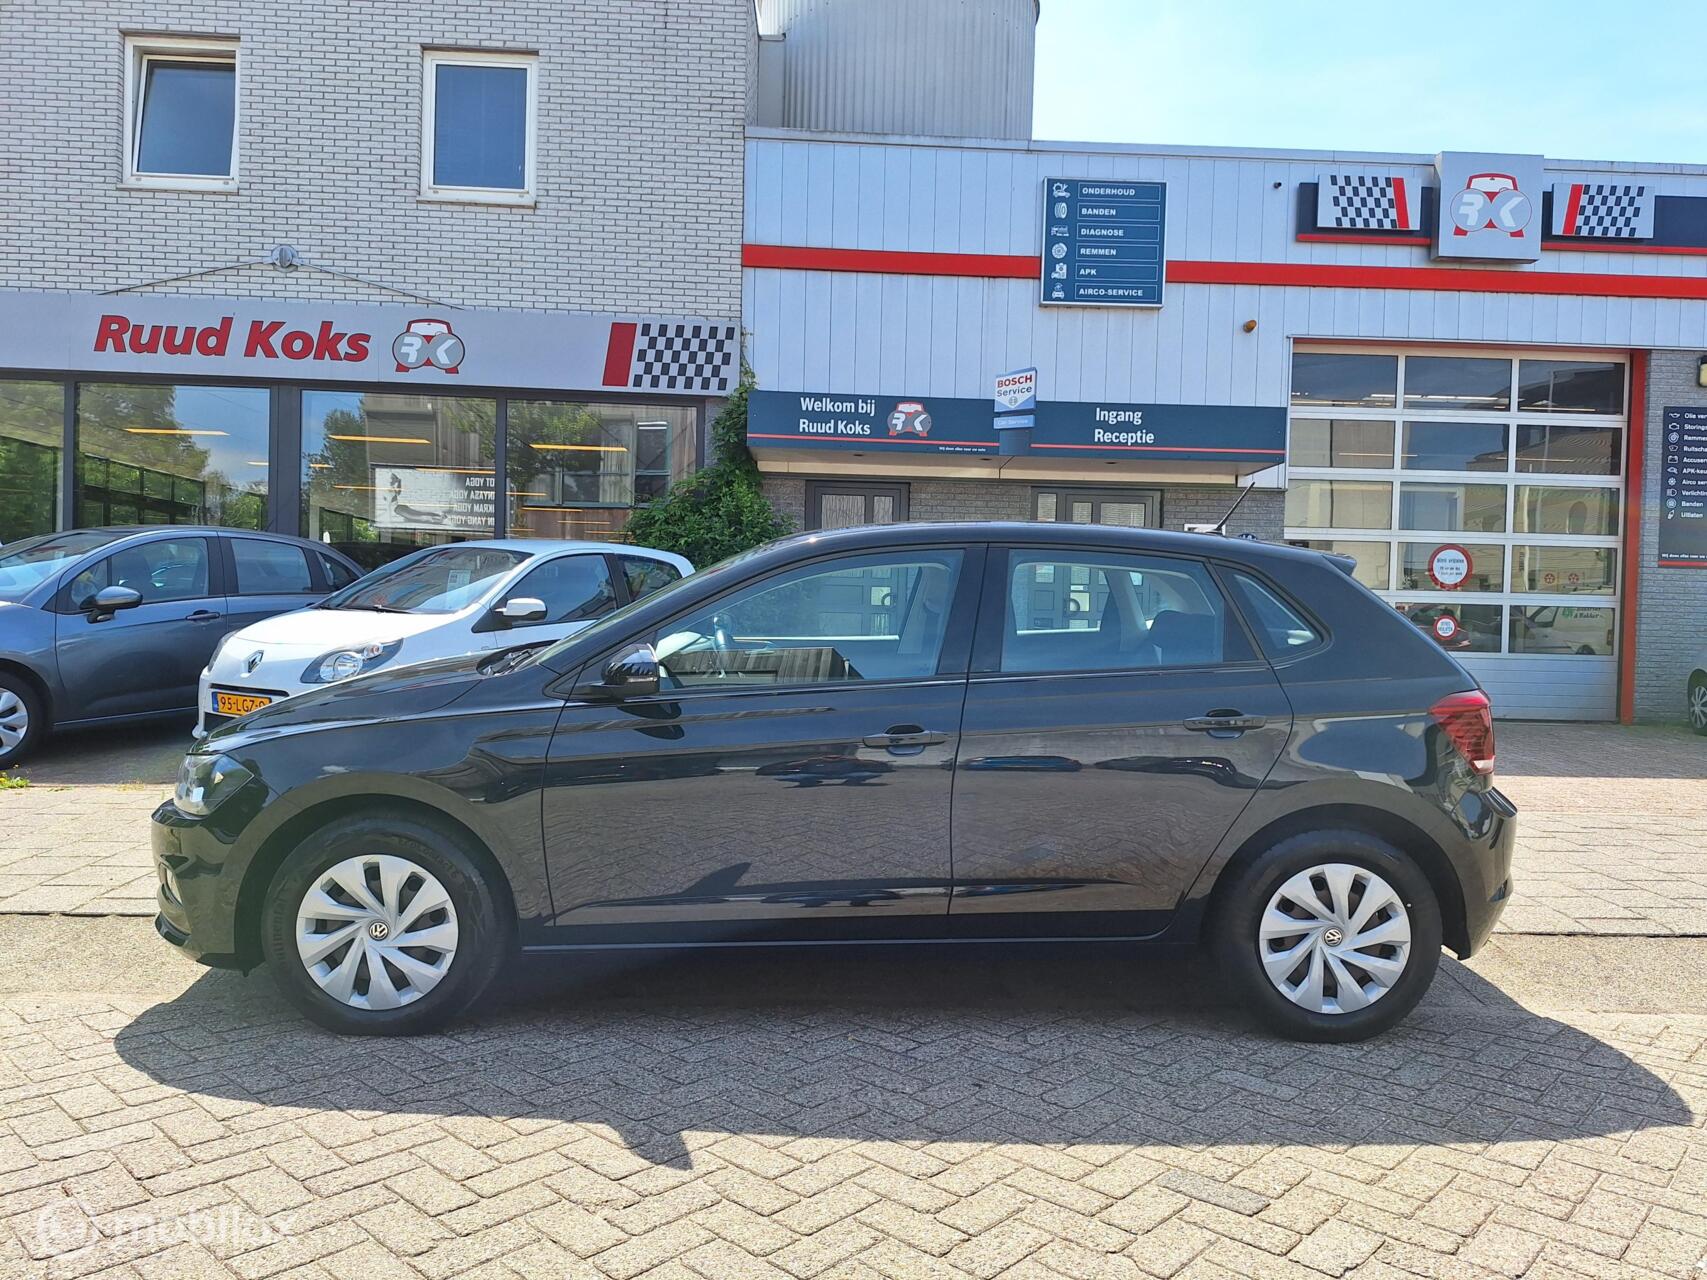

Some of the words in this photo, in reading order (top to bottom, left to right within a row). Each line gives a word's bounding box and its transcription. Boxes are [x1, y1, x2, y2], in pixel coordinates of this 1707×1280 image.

[1082, 187, 1136, 196] ONDERHOUD
[1081, 208, 1116, 216] BANDEN
[1081, 228, 1124, 236] DIAGNOSE
[1080, 248, 1117, 256] REMMEN
[1079, 288, 1143, 296] AIRCO-SERVICE
[93, 314, 234, 357] Ruud
[243, 320, 372, 362] Koks
[997, 374, 1033, 388] BOSCH
[997, 385, 1032, 397] Service
[800, 397, 855, 413] Welkom
[858, 399, 876, 416] bij
[1095, 407, 1142, 425] Ingang
[799, 418, 834, 434] Ruud
[838, 420, 871, 435] Koks
[1094, 428, 1155, 446] Receptie
